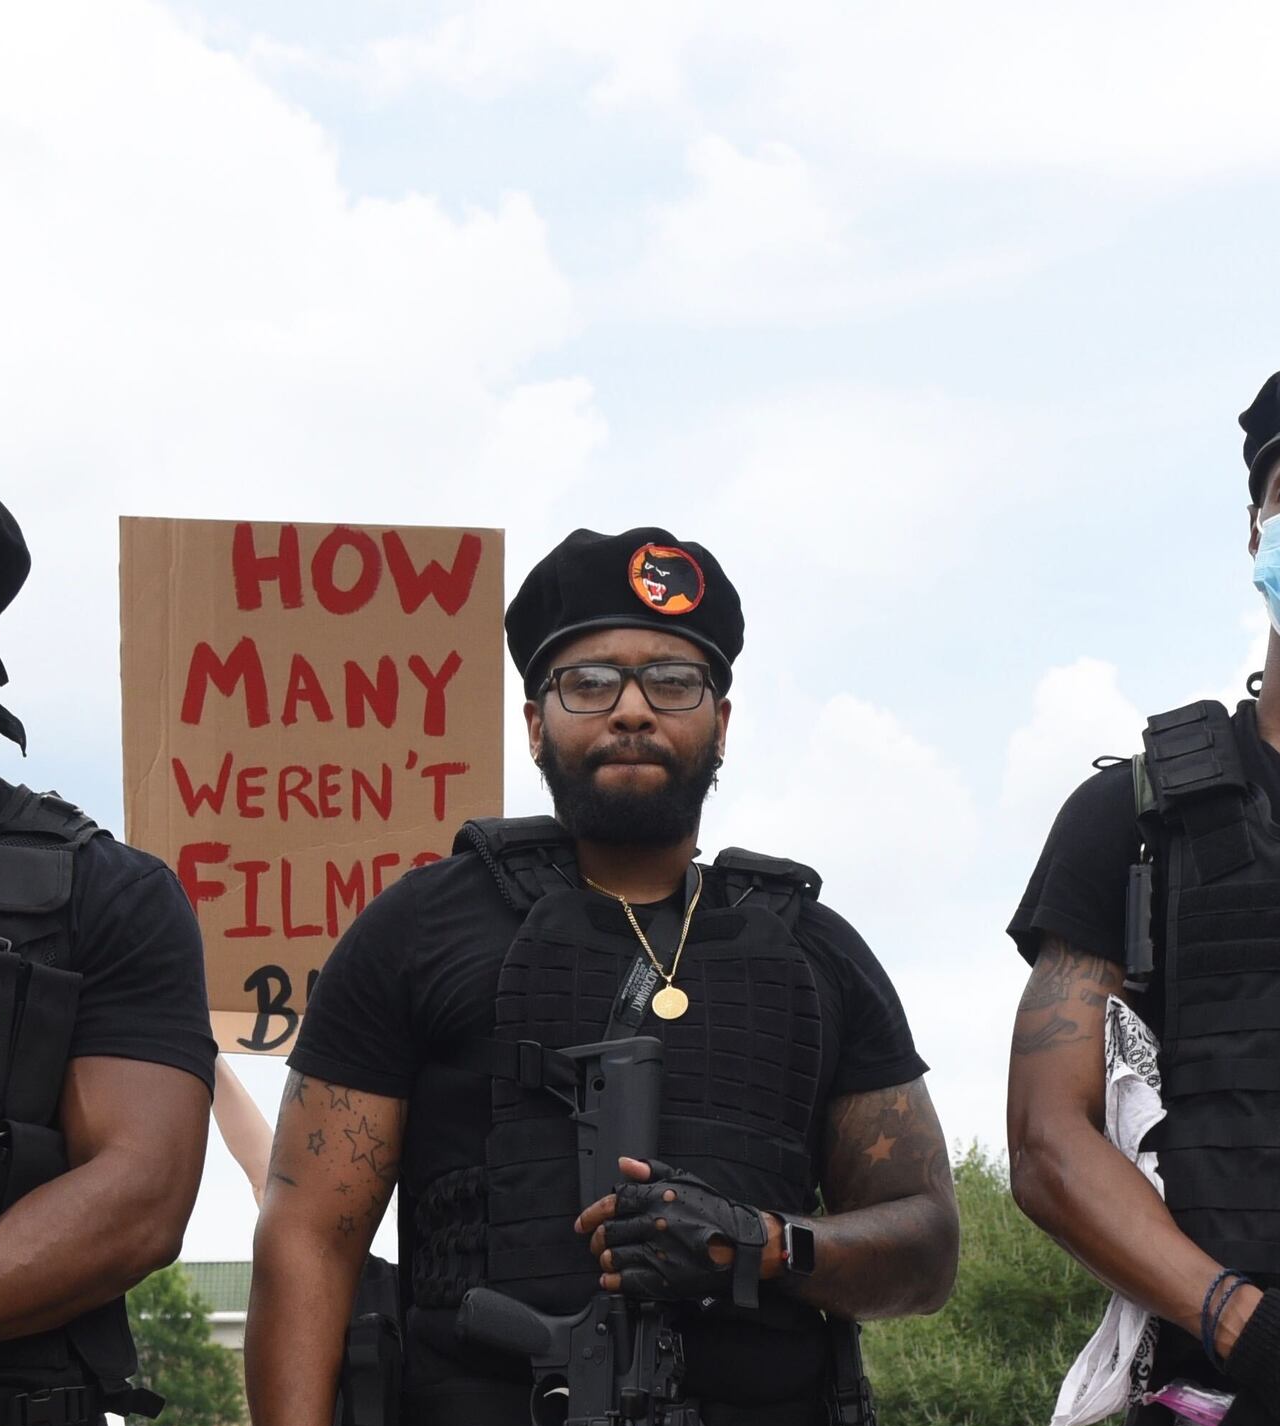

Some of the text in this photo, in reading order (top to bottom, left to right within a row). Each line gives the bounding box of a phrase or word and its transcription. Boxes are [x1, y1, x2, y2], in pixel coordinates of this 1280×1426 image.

[231, 522, 482, 616] HOW
[180, 636, 464, 737] MANY
[171, 749, 472, 822] WEREN'T
[176, 841, 446, 940] FILM
[236, 964, 320, 1052] B
